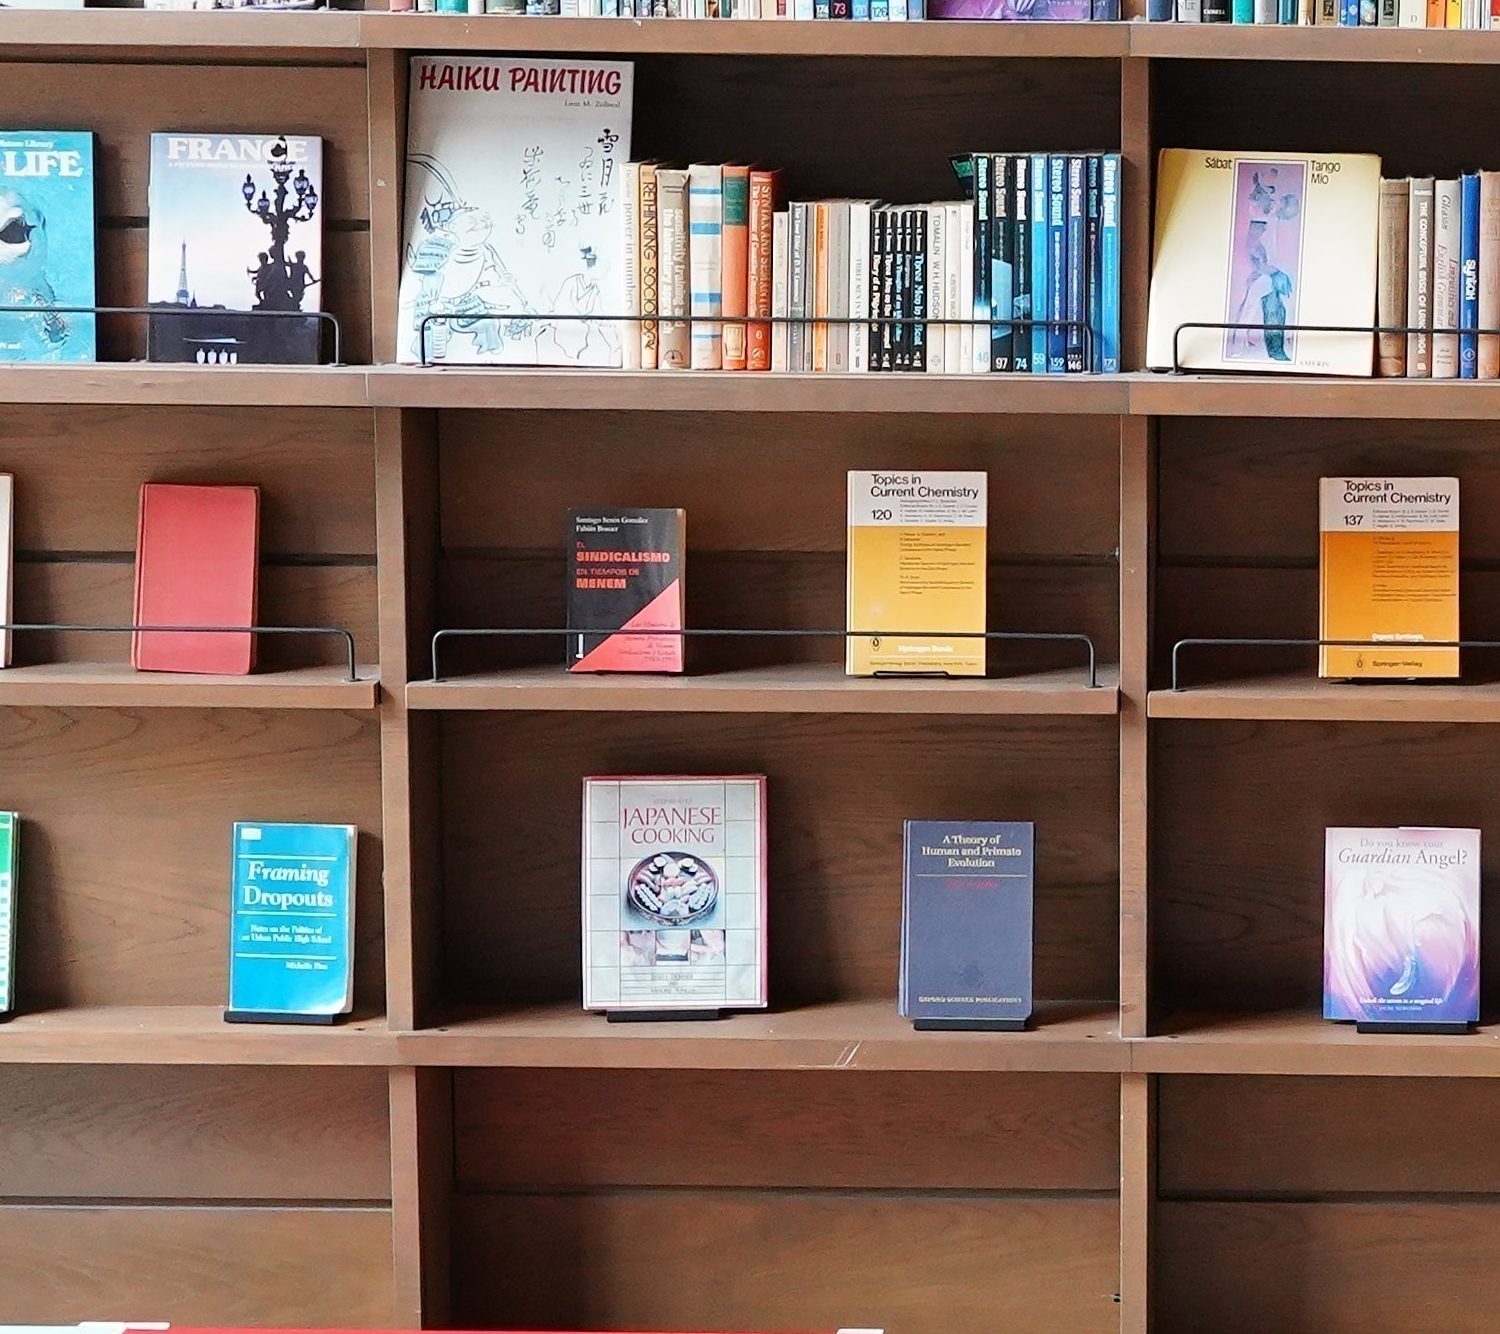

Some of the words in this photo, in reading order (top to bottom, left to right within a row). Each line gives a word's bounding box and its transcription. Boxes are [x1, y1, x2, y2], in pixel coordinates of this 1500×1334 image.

[419, 61, 500, 91] HAIKU
[507, 64, 623, 95] PAINTING
[166, 136, 309, 163] FRANCE
[10, 149, 85, 178] LIFE
[870, 474, 908, 487] Topics
[911, 474, 921, 486] in
[870, 486, 915, 498] Current
[918, 486, 979, 501] Chemistry
[870, 509, 892, 521] 120
[575, 551, 671, 564] SINDICALISMO
[575, 577, 627, 591] MENEM
[622, 806, 722, 827] JAPANESE
[631, 827, 715, 844] COOKING
[245, 861, 330, 884] Framing
[242, 886, 333, 910] Dropouts
